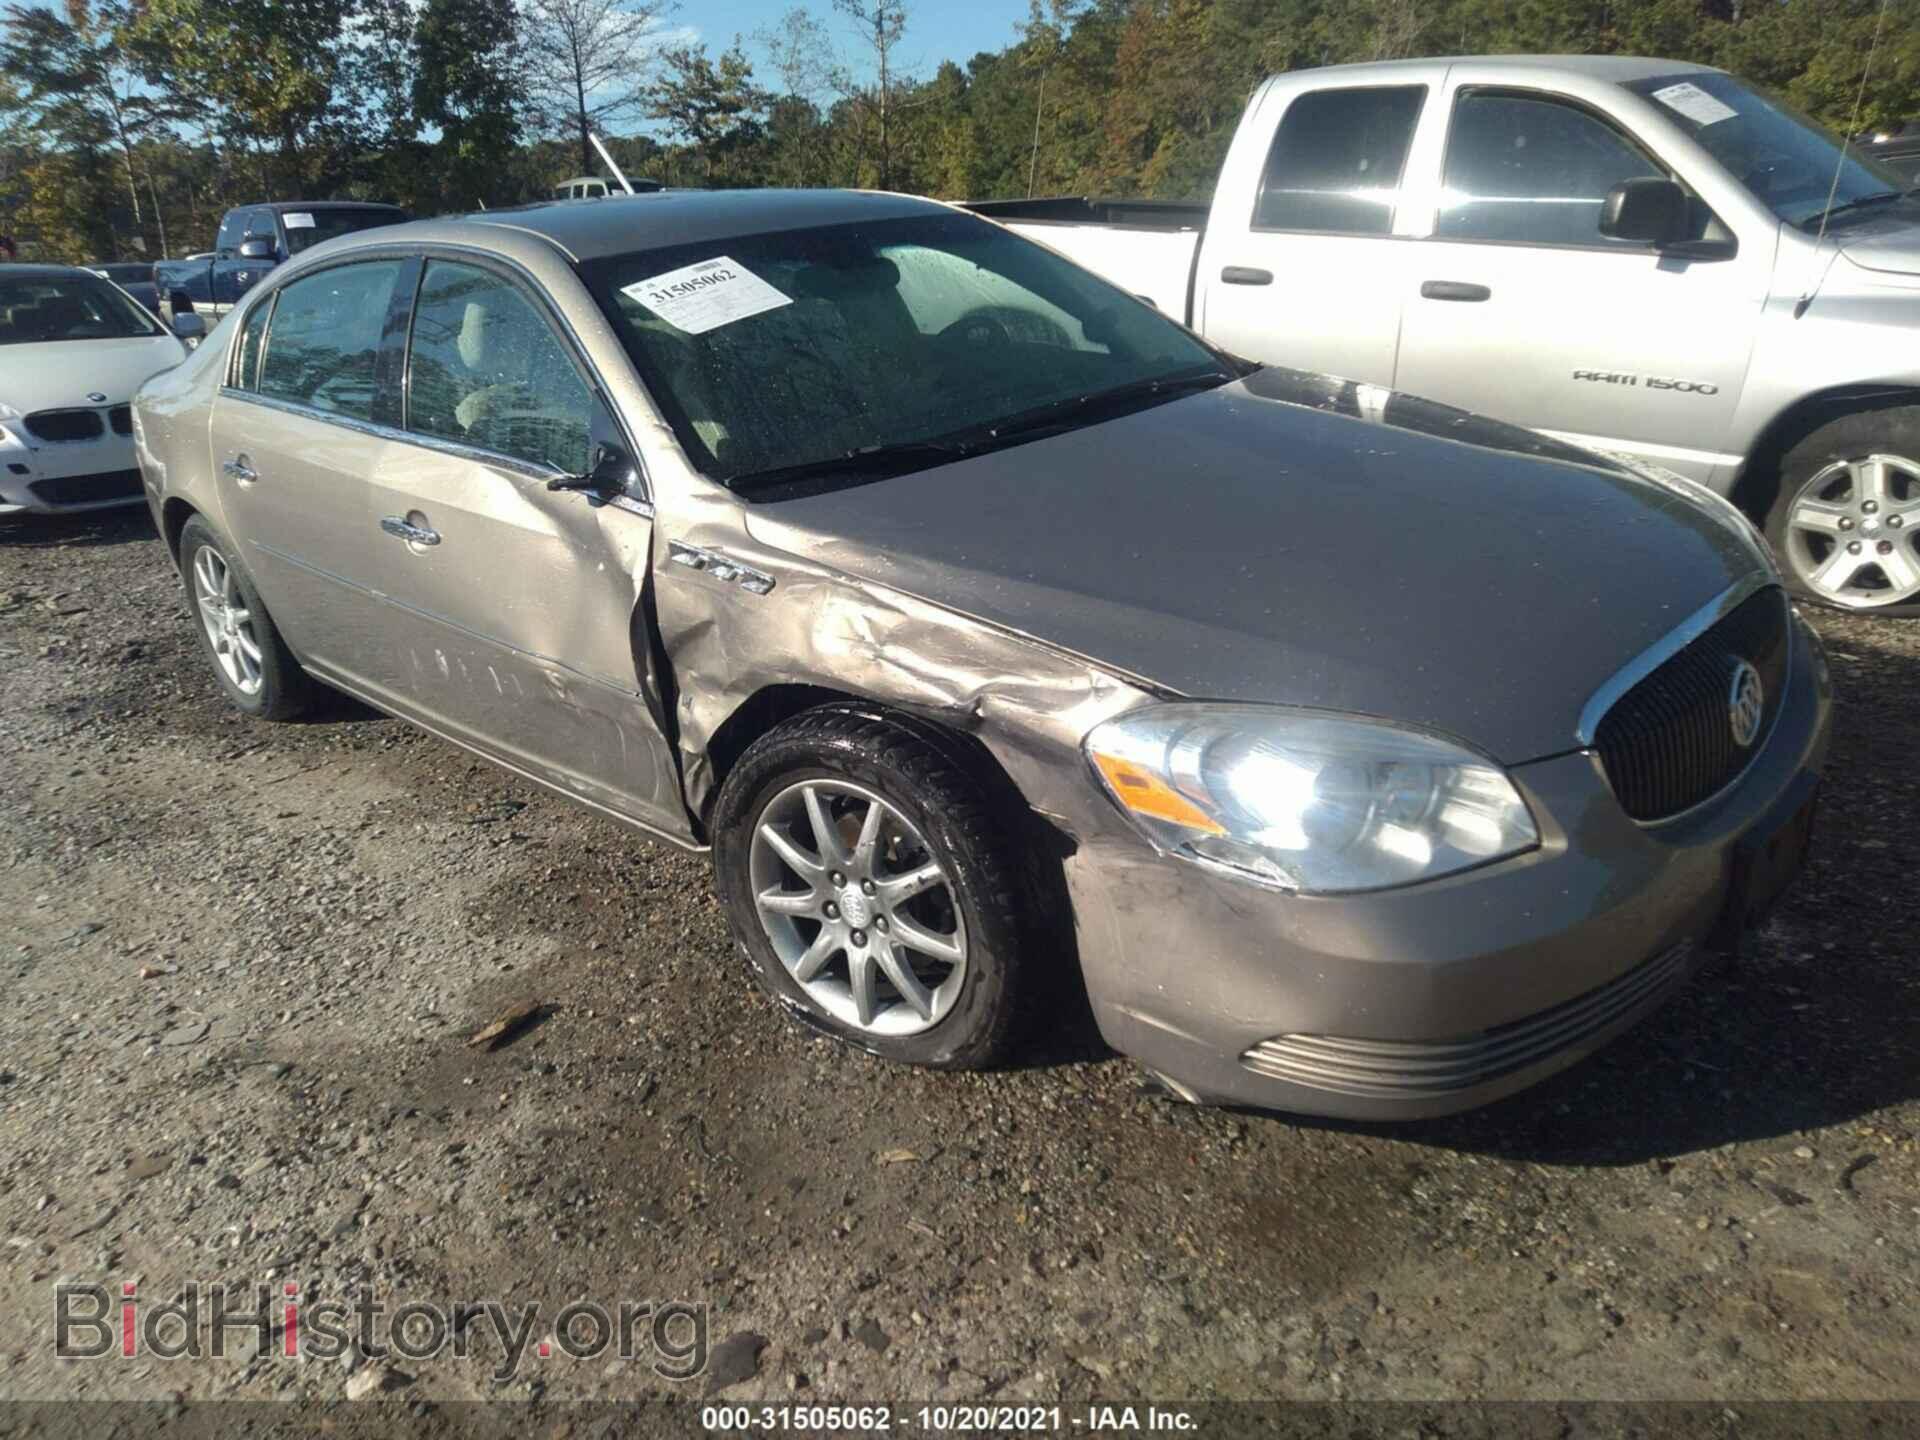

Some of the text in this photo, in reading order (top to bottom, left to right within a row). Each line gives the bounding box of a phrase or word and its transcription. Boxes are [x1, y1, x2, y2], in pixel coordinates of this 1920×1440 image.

[649, 269, 737, 303] 31505062
[1573, 370, 1719, 396] RAM 1500
